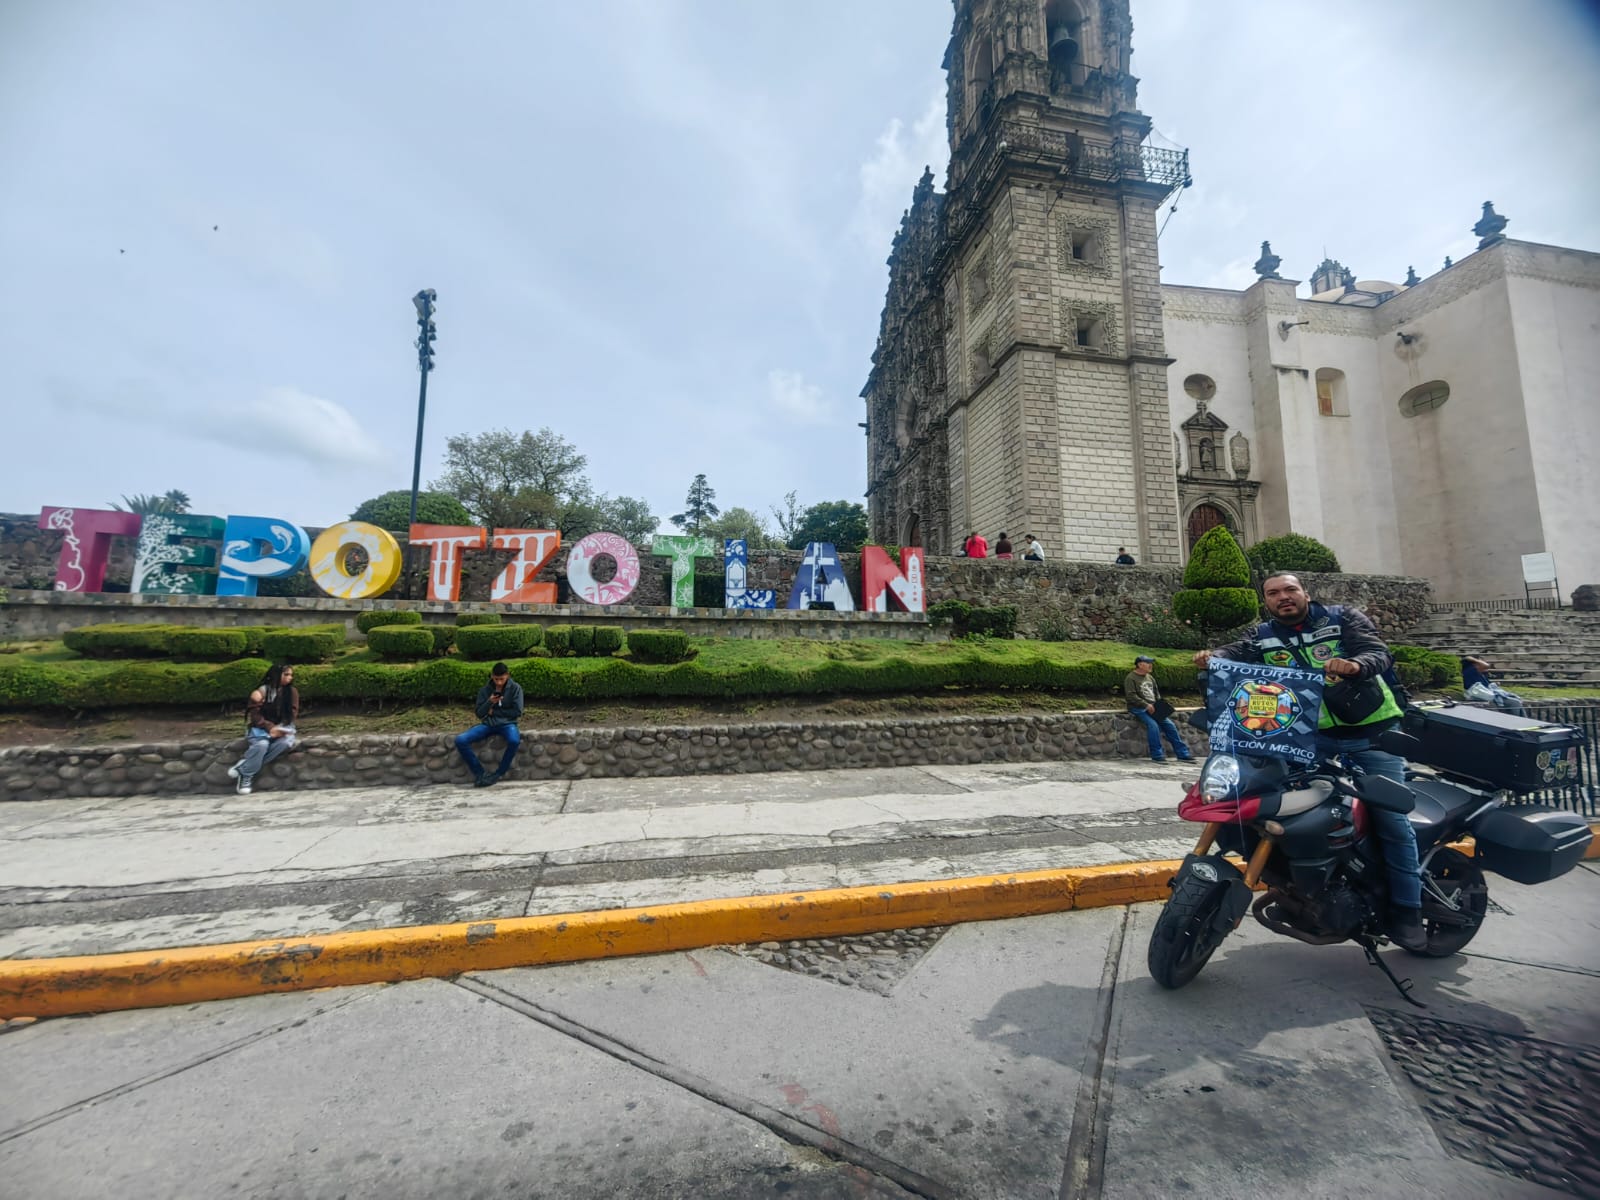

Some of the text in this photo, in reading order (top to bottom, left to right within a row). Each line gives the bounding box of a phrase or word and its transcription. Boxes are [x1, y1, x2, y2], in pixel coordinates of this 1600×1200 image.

[39, 505, 927, 613] TEPOTZOTLAN
[1209, 662, 1325, 683] MOTOTURISTA
[1269, 743, 1315, 759] MÉXICO
